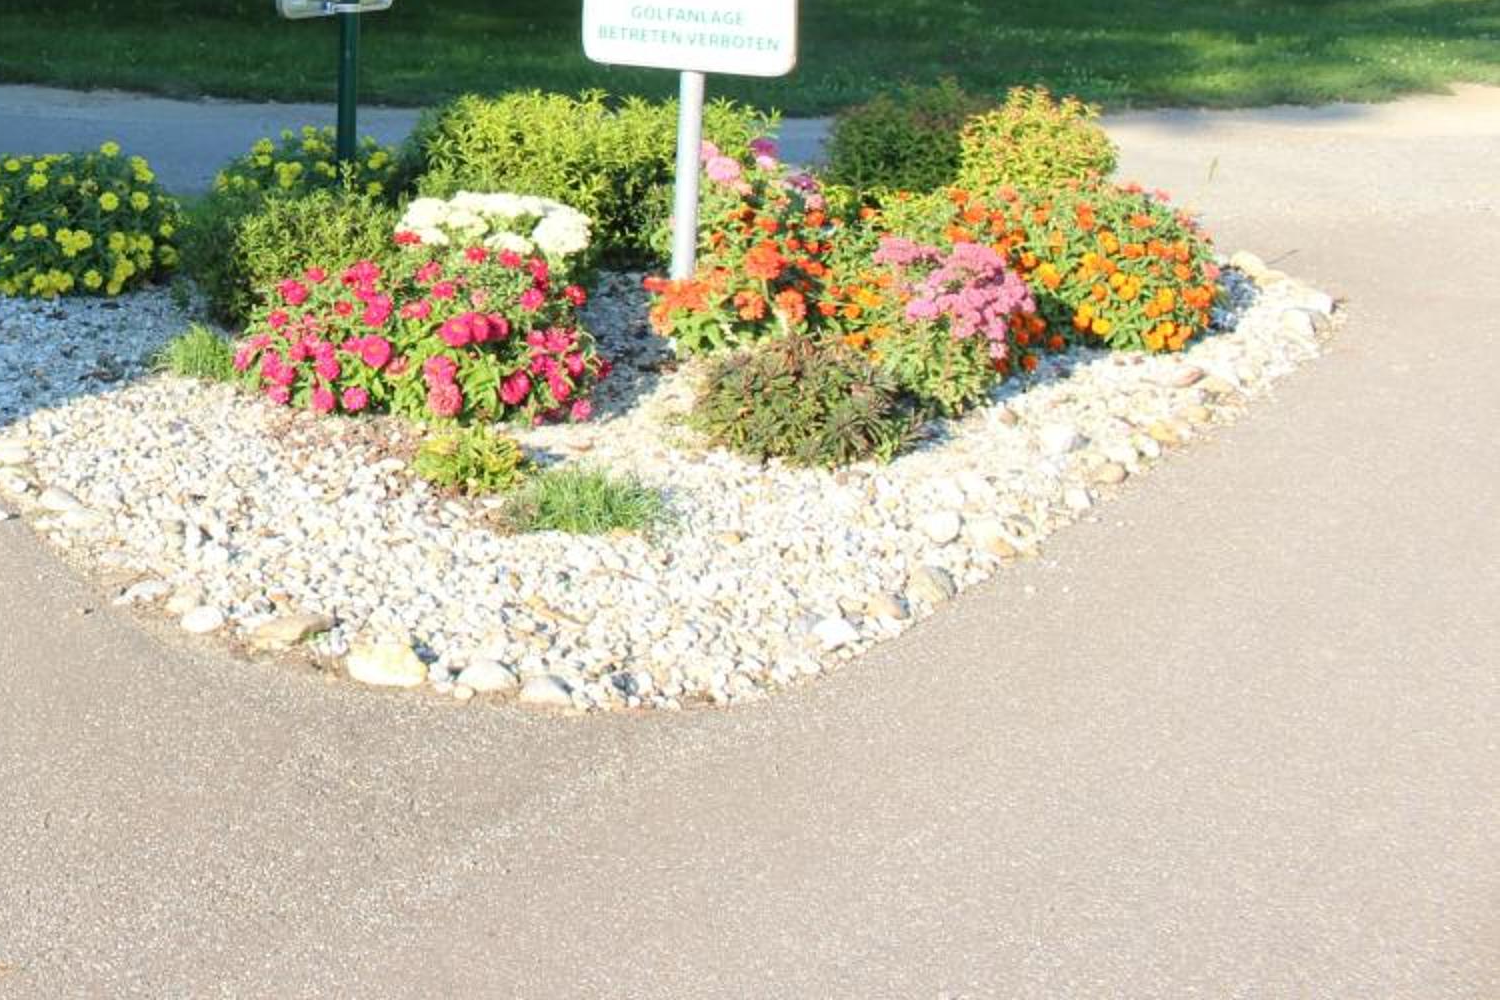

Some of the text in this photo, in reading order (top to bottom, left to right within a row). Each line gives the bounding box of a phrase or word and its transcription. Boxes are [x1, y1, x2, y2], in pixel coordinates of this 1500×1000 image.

[631, 5, 744, 25] GOLFANLAGE
[597, 24, 781, 52] BETRETEN VERBOTEN
